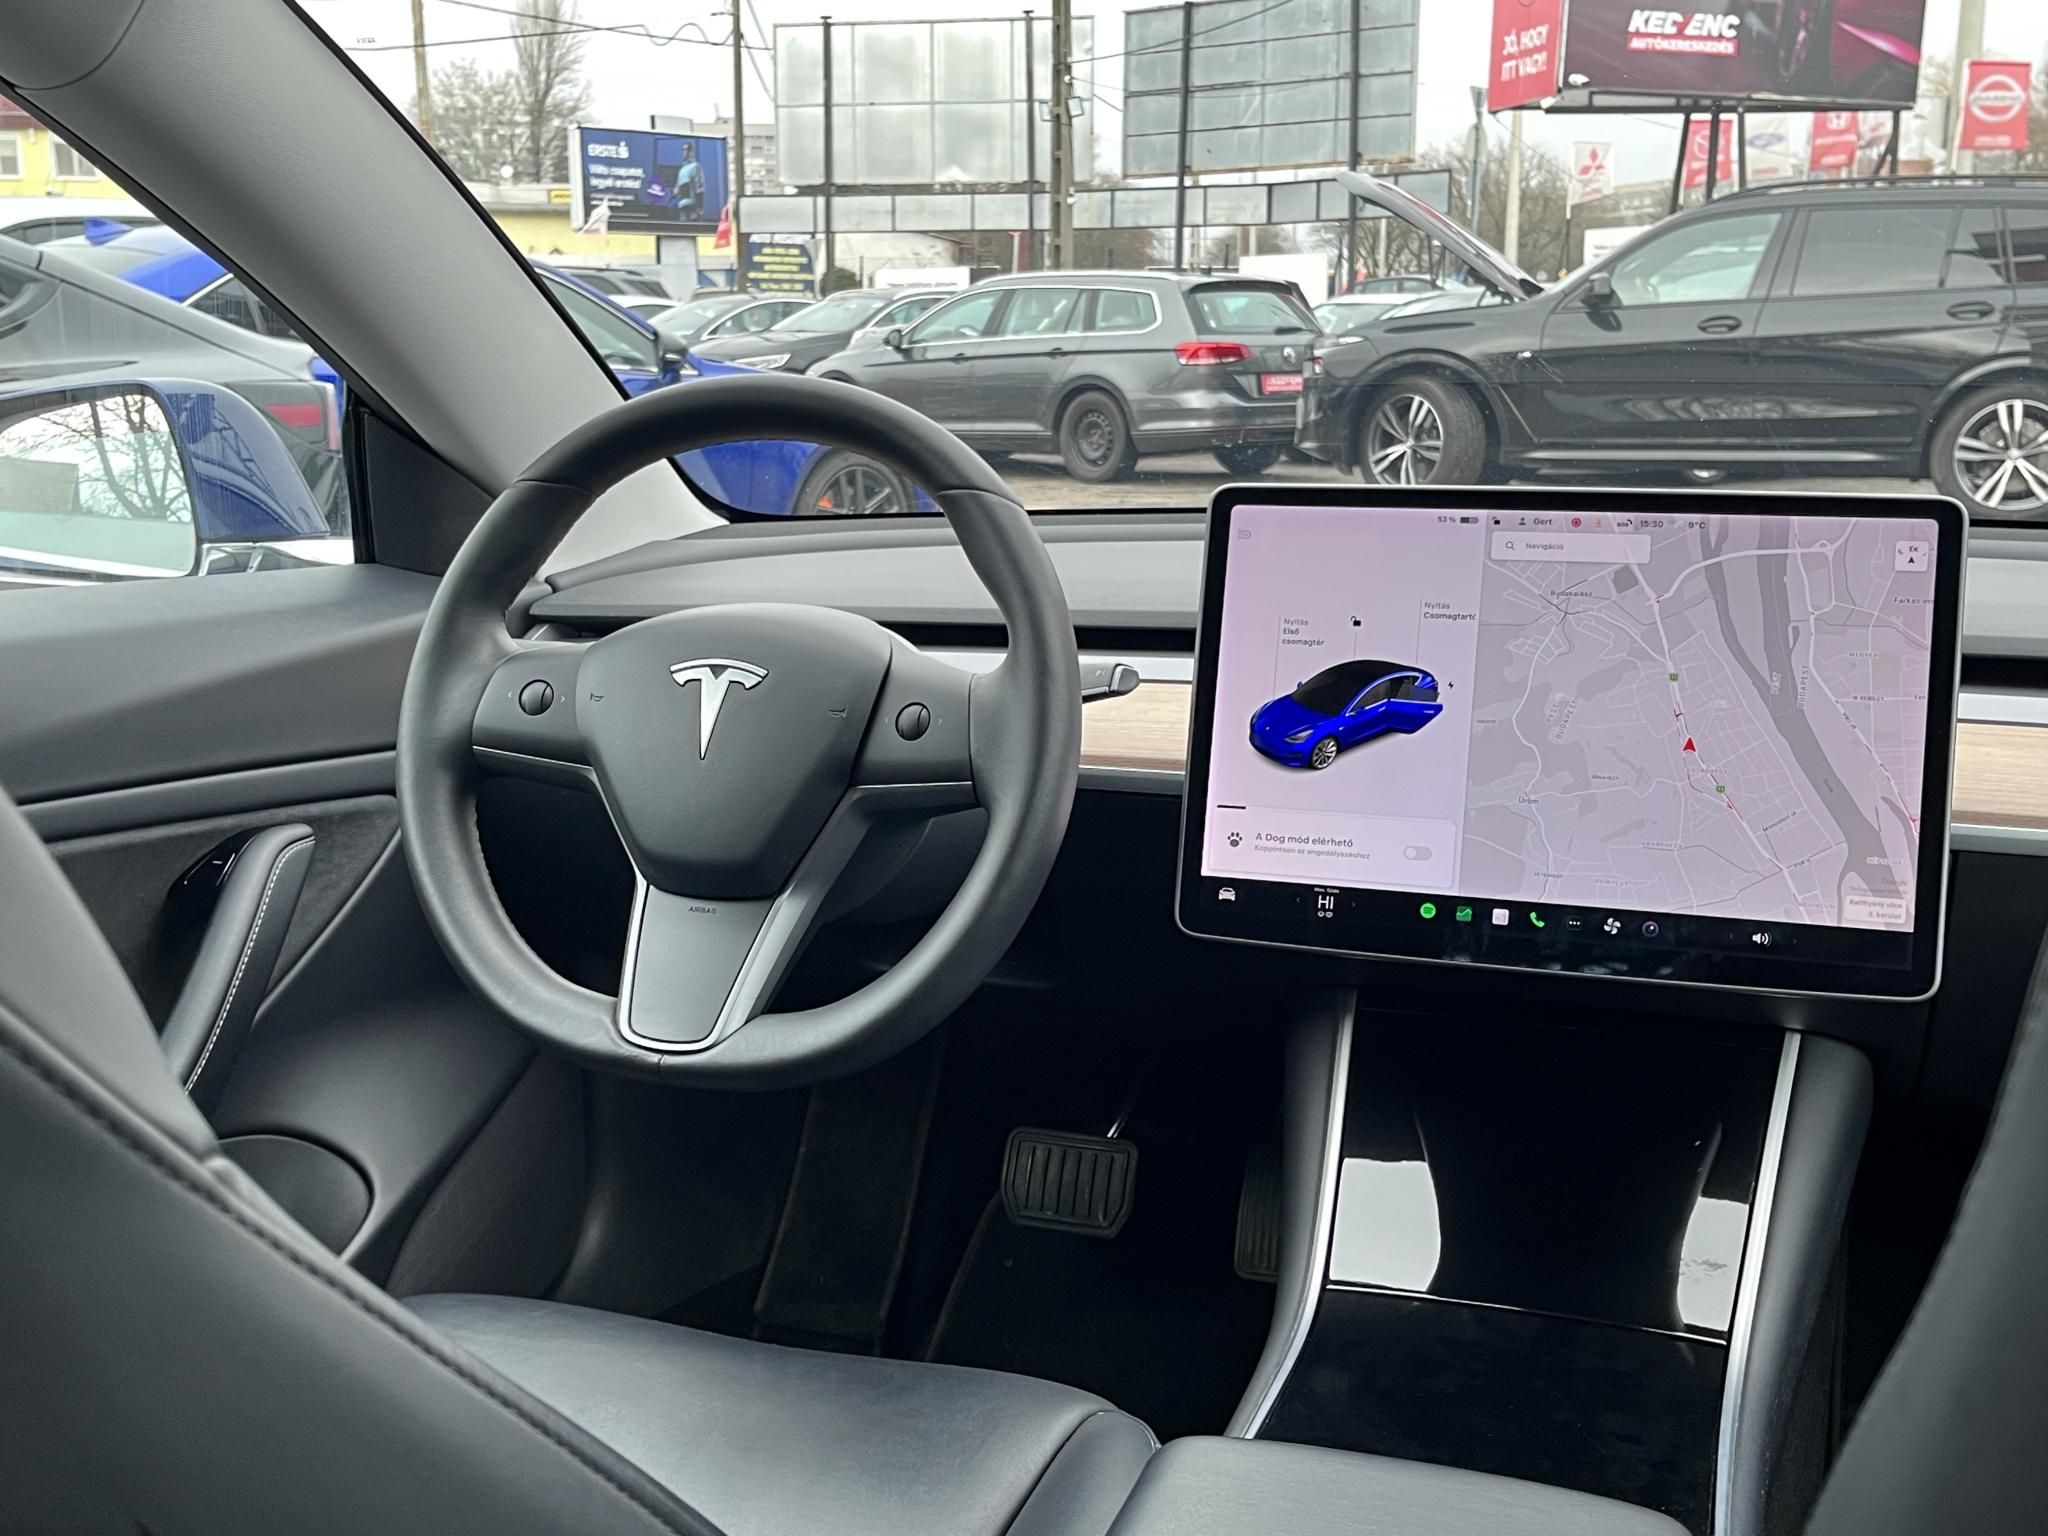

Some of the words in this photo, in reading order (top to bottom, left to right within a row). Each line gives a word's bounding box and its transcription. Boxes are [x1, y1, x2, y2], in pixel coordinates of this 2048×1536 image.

[1520, 24, 1549, 50] HOGY
[1500, 58, 1517, 82] ITT
[1517, 51, 1548, 77] VAGY!
[1533, 517, 1553, 526] Gert
[1640, 520, 1664, 528] 15:30
[1688, 521, 1706, 529] 9°C
[1526, 542, 1564, 551] Navigáció
[1424, 602, 1450, 611] Nyitás
[1284, 618, 1309, 627] Nyitás
[1283, 627, 1300, 636] Első
[1281, 638, 1325, 648] csomagtér
[1255, 832, 1263, 841] A
[1265, 833, 1285, 844] Dog
[1287, 835, 1310, 845] mód
[1311, 836, 1353, 848] elérhető
[1317, 894, 1334, 910] HI
[688, 906, 717, 915] AIRBAG
